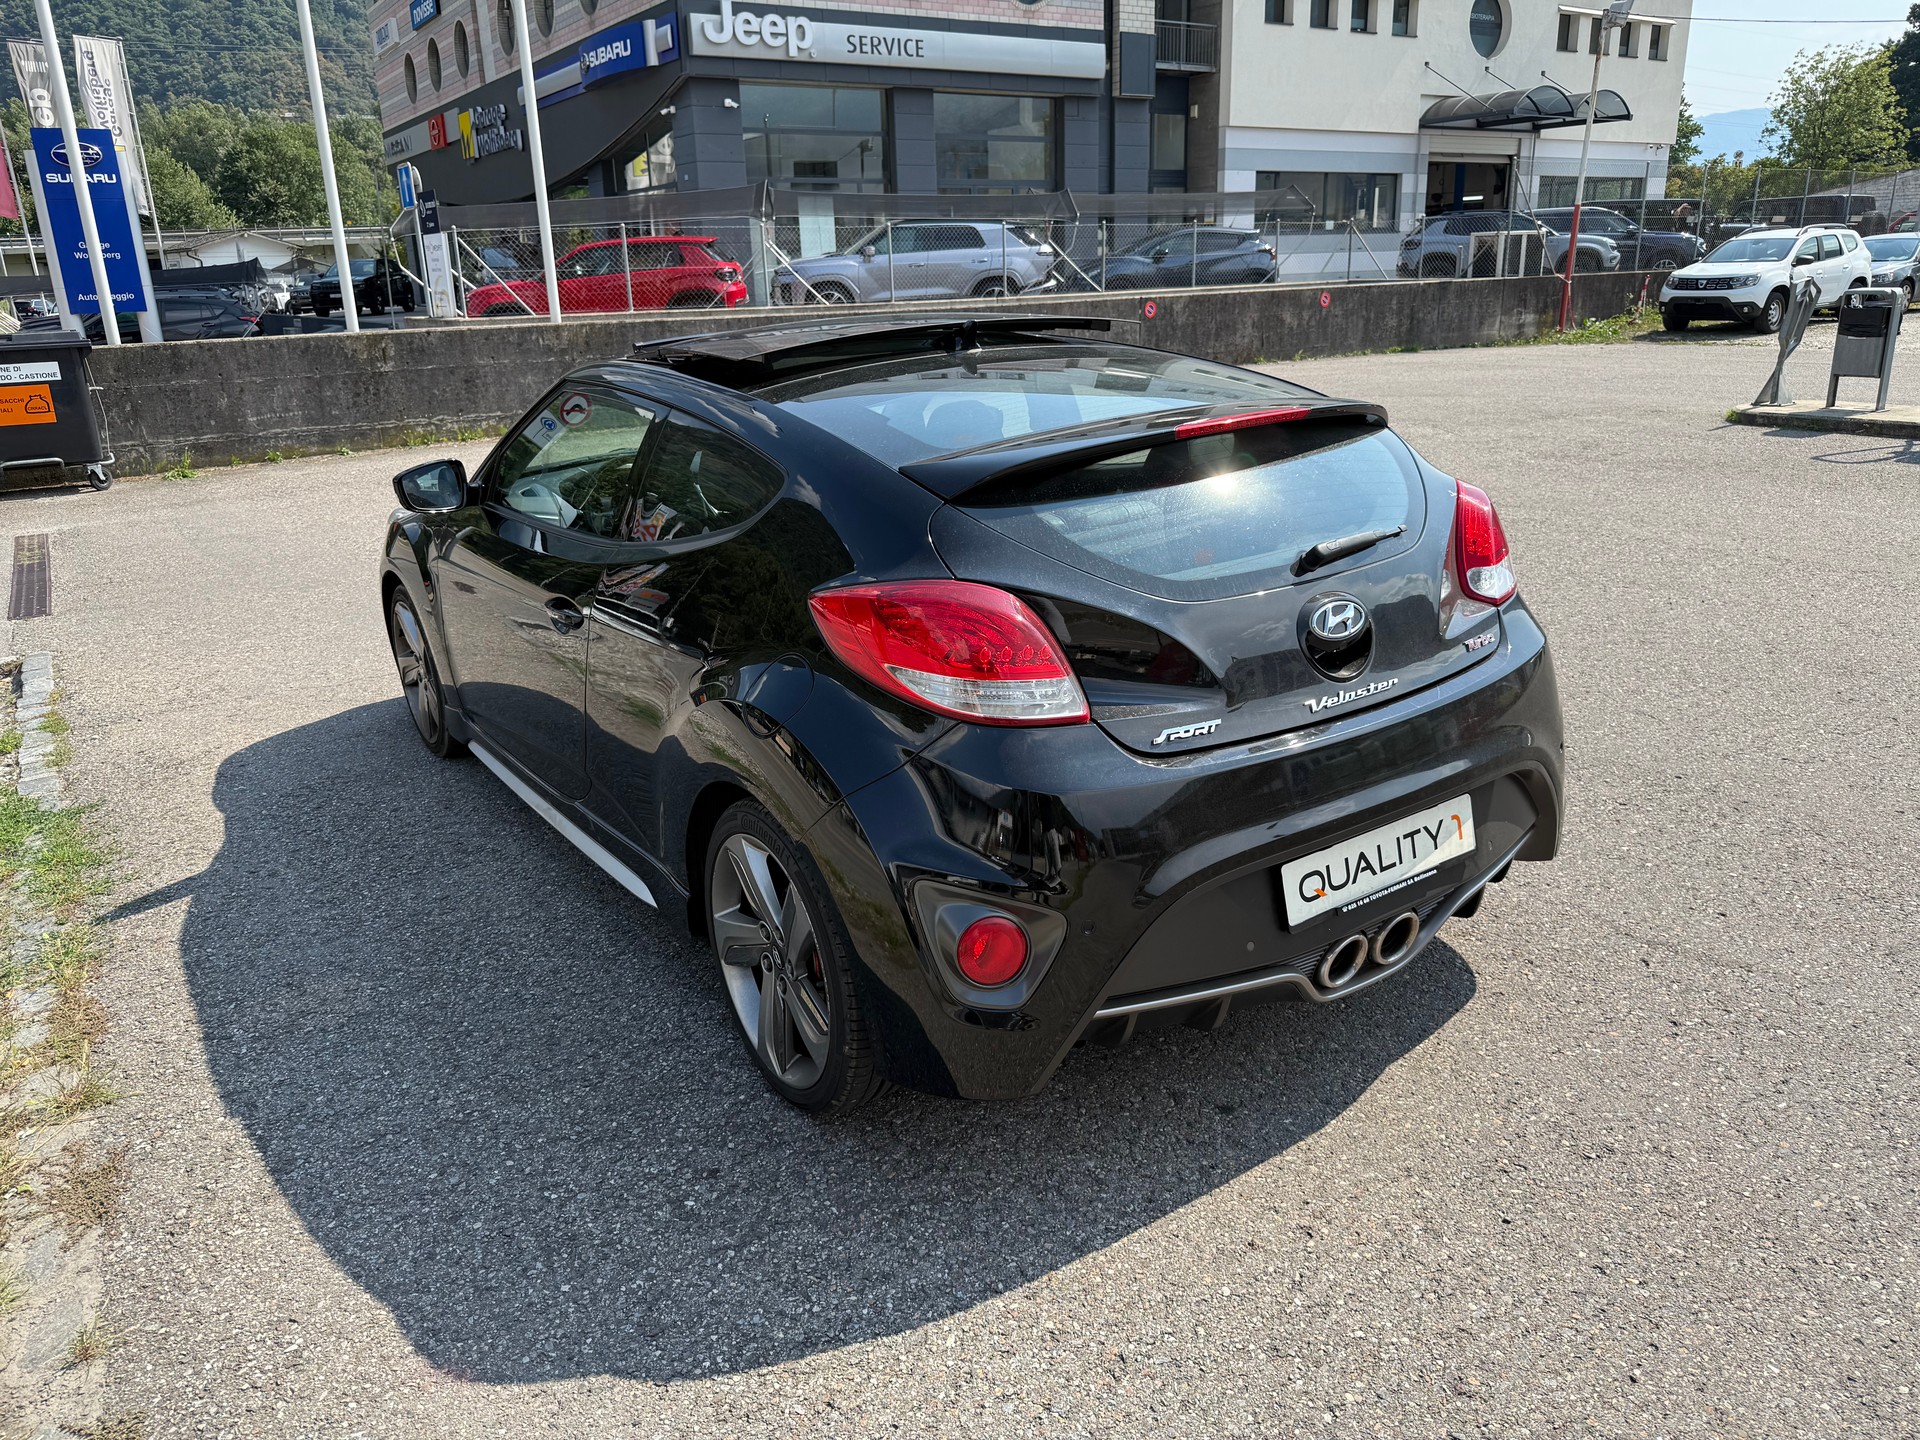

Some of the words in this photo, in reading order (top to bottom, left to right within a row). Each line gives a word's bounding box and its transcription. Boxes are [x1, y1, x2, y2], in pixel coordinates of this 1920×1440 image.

[703, 0, 813, 57] Jeep
[589, 39, 631, 68] SUBARU
[847, 34, 925, 58] SERVICE
[475, 104, 507, 128] Garage
[45, 173, 117, 184] SUARU
[74, 251, 121, 260] Woberg
[78, 241, 111, 250] Gge
[18, 371, 59, 380] CASTIONE
[1304, 678, 1398, 714] Veloster
[1153, 718, 1222, 746] SPORT
[1299, 819, 1444, 903] QUALITY
[1451, 814, 1463, 840] 1
